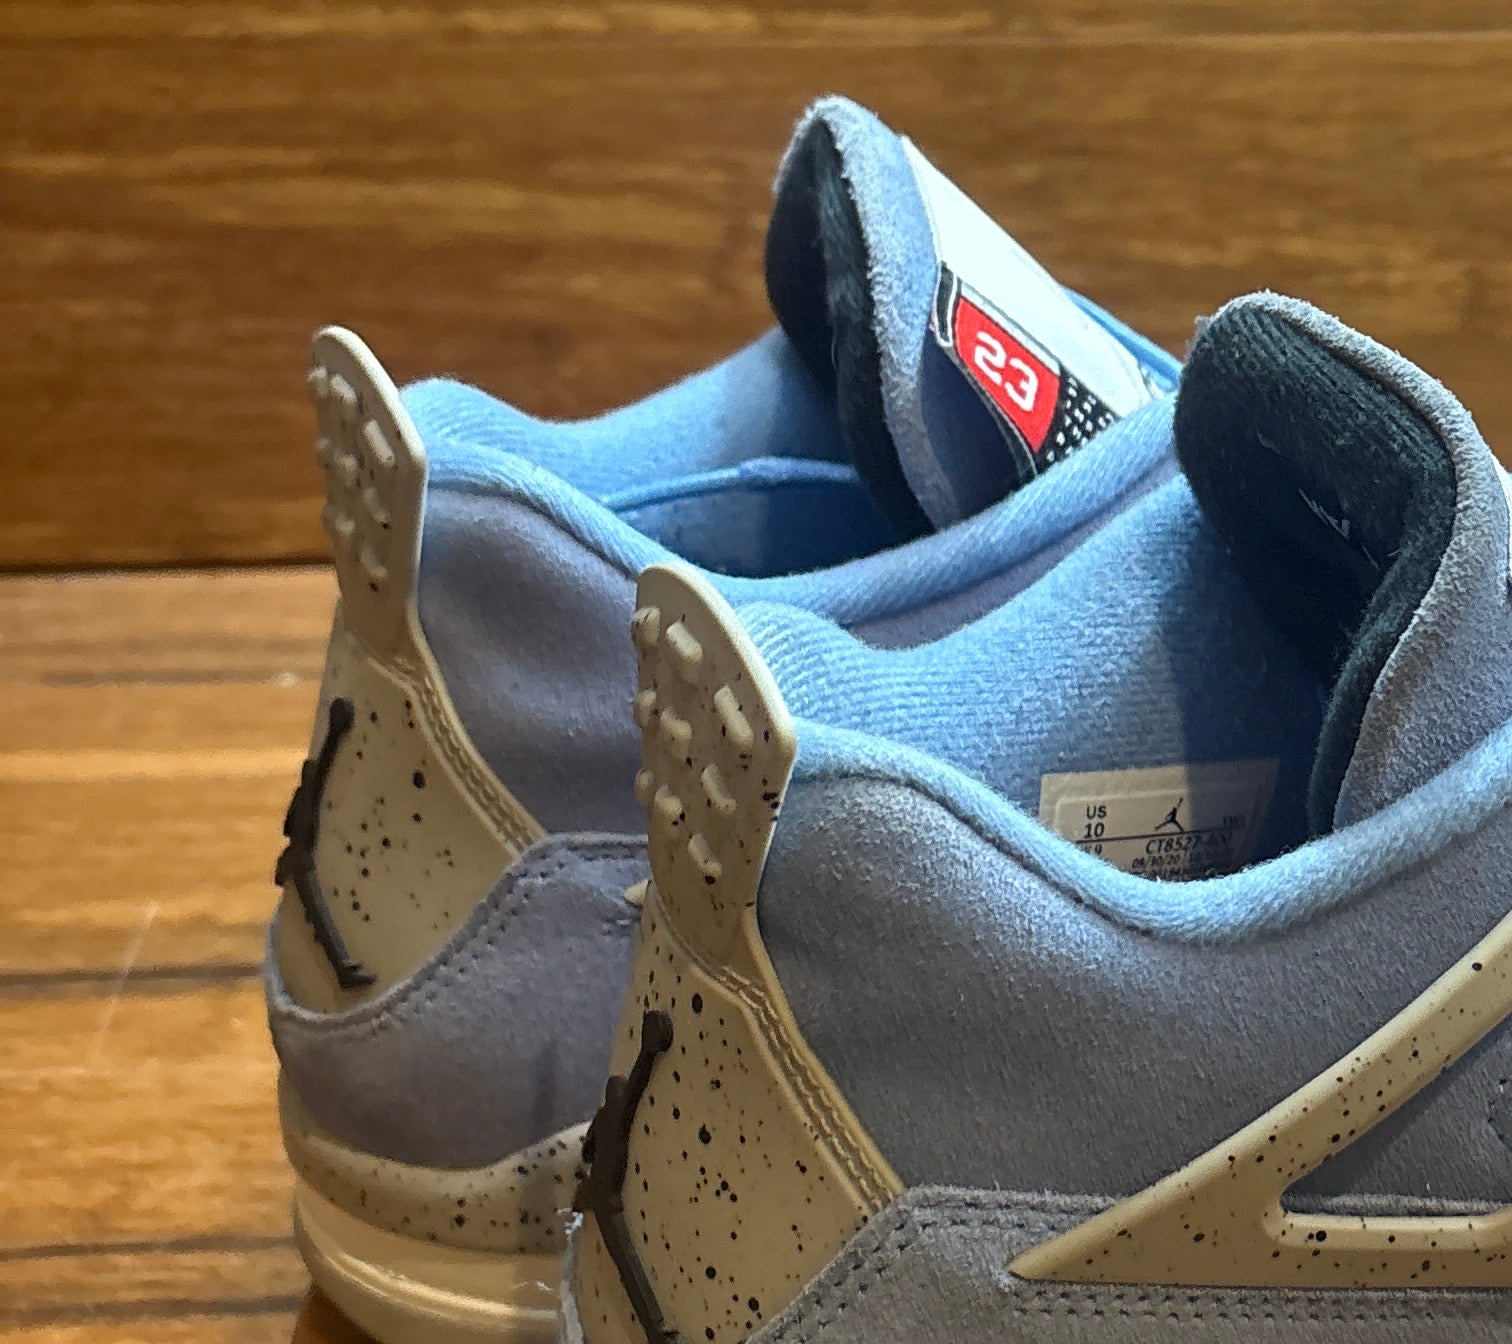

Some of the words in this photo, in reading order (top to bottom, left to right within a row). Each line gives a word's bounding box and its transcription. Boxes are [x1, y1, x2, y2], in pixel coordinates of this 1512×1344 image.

[973, 330, 1039, 413] 23
[1086, 805, 1107, 819] US
[1084, 822, 1105, 838] 10
